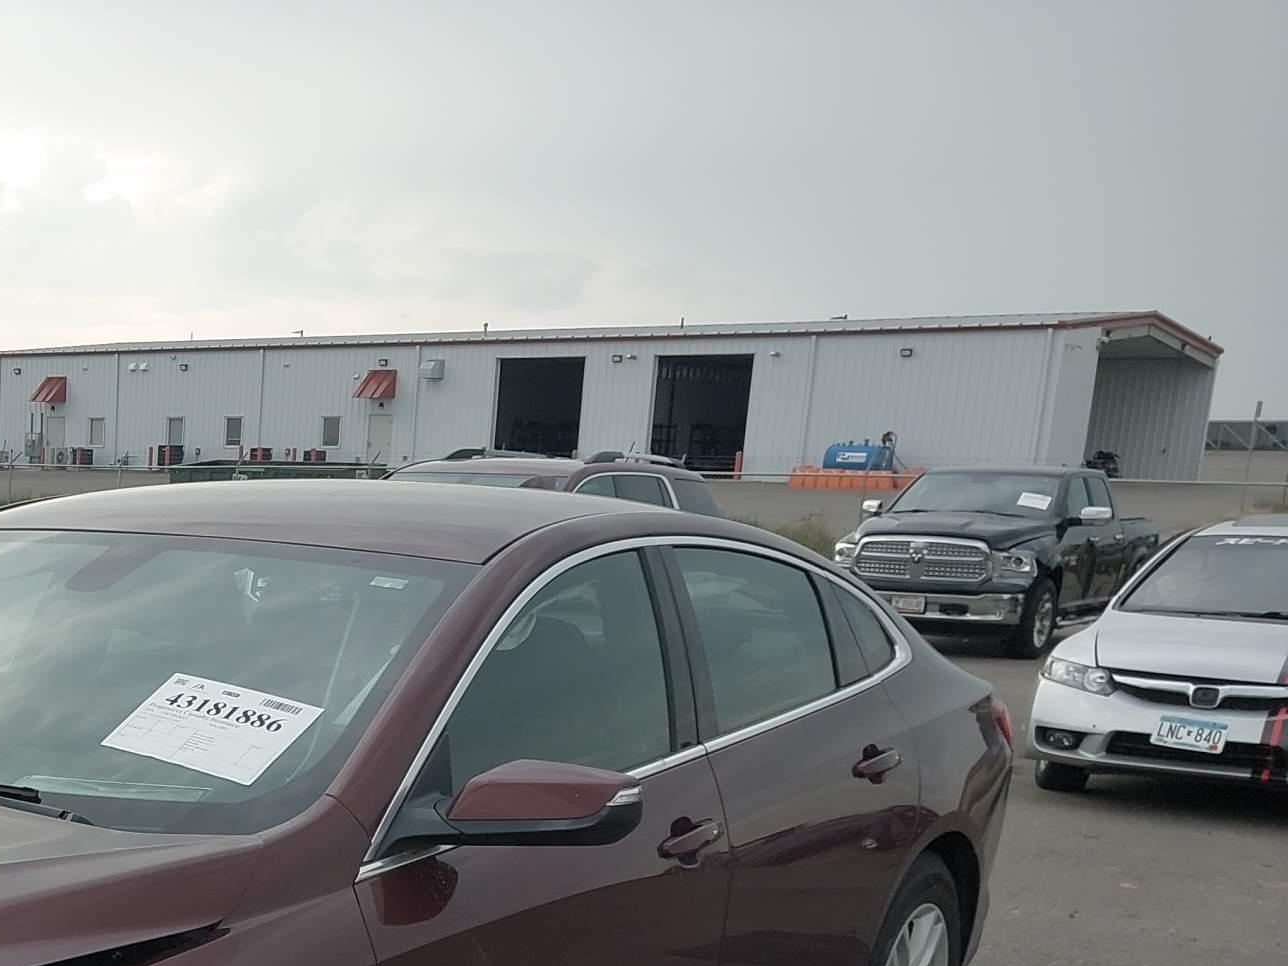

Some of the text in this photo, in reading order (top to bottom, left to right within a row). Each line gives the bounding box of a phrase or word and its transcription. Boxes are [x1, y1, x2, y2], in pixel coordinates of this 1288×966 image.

[165, 693, 288, 733] 43181886
[1157, 722, 1186, 740] LNC
[1194, 727, 1222, 745] 840
